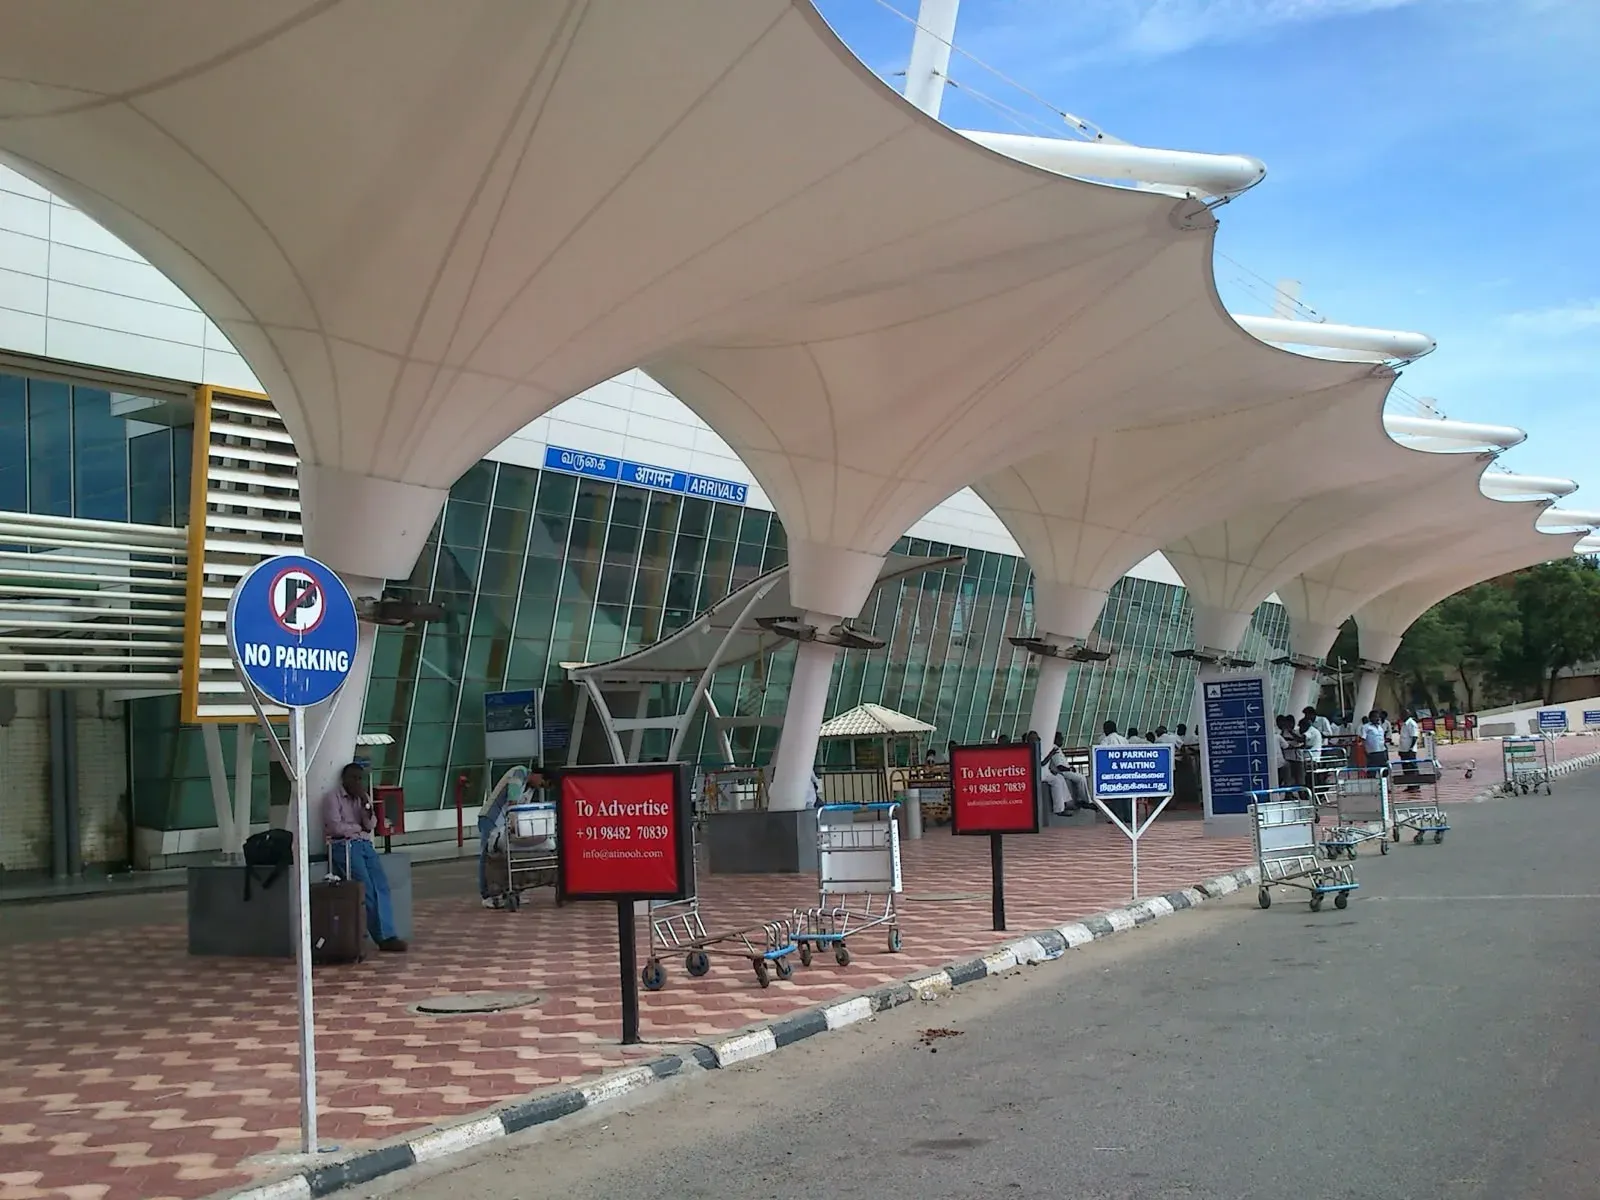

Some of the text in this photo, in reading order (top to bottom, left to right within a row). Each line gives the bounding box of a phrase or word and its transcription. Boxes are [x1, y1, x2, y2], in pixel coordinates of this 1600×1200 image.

[561, 451, 606, 471] வருகை
[635, 466, 675, 488] आगमन
[690, 479, 744, 501] ARRIVALS
[244, 643, 349, 673] NO PARKING
[1108, 750, 1159, 759] NO PARKING
[960, 765, 1026, 779] To Advertise
[1111, 761, 1156, 770] & WAITING
[575, 798, 669, 817] To Advertise
[600, 826, 631, 840] 98482
[637, 825, 669, 840] 70839
